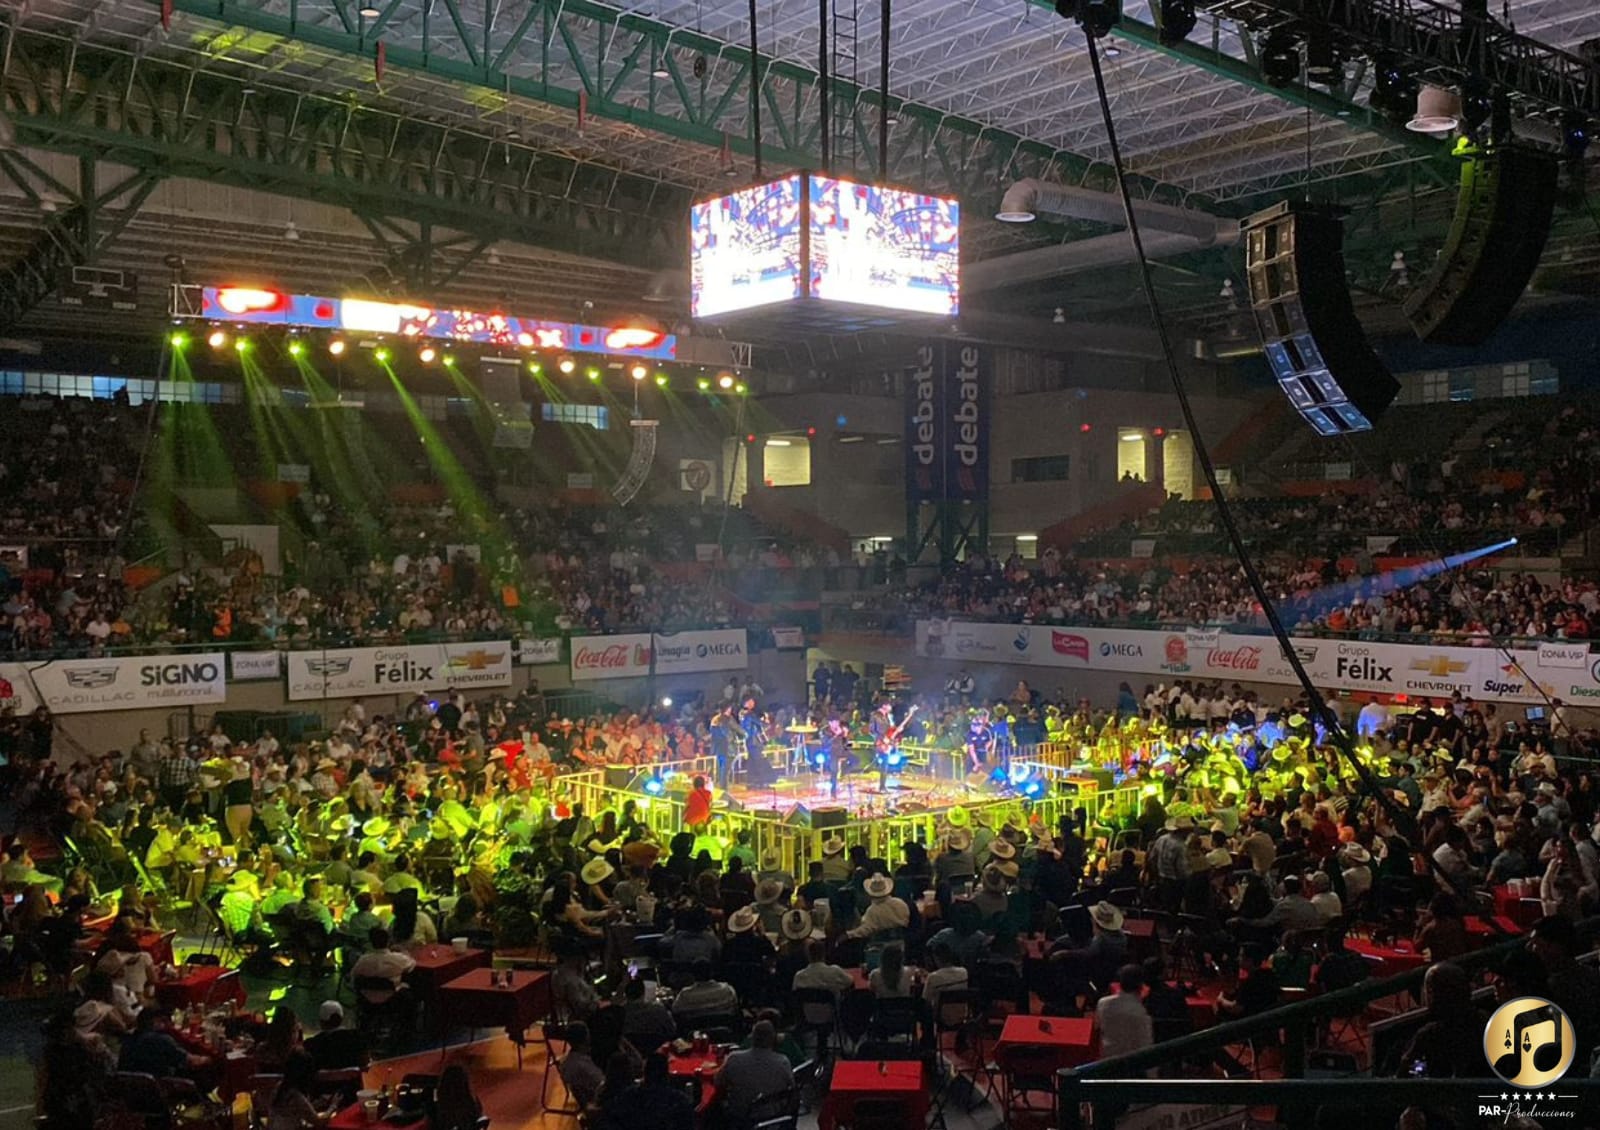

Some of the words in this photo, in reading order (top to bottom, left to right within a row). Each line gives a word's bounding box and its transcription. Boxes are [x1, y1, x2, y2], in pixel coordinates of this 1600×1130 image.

[912, 346, 934, 464] debate
[953, 346, 978, 465] debate
[1337, 643, 1369, 656] Grupo
[1541, 650, 1566, 658] ZONA
[1568, 651, 1584, 659] VIP
[375, 650, 409, 662] Grupo
[375, 660, 433, 683] Félix
[1267, 667, 1328, 679] CADIAC
[1337, 657, 1393, 682] Félix
[447, 672, 507, 683] CHEVROLET
[292, 680, 366, 692] CADLLAC
[1407, 680, 1472, 692] CHEVROLET
[49, 691, 136, 705] CADILLAC
